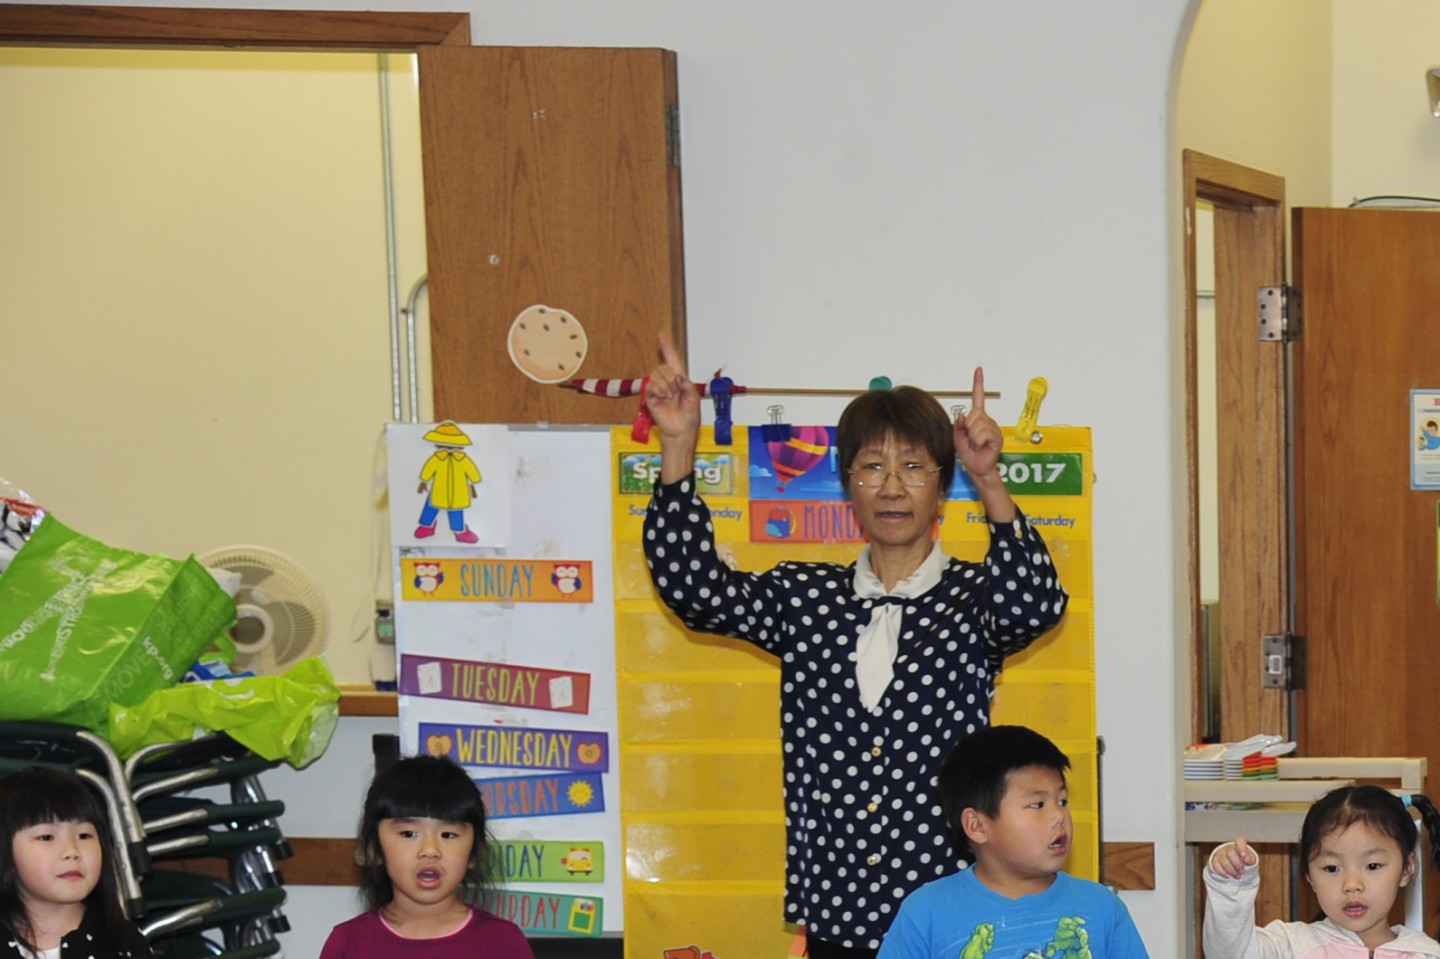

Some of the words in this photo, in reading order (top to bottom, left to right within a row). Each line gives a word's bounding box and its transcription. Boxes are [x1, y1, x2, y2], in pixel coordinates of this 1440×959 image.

[633, 462, 720, 484] Spng
[997, 462, 1066, 483] 2017
[804, 504, 864, 539] MOND
[460, 562, 535, 598] SUNDAY
[451, 662, 540, 705] TUESDAY
[456, 728, 573, 768] WEDNESDAY
[482, 778, 560, 816] URSDAY
